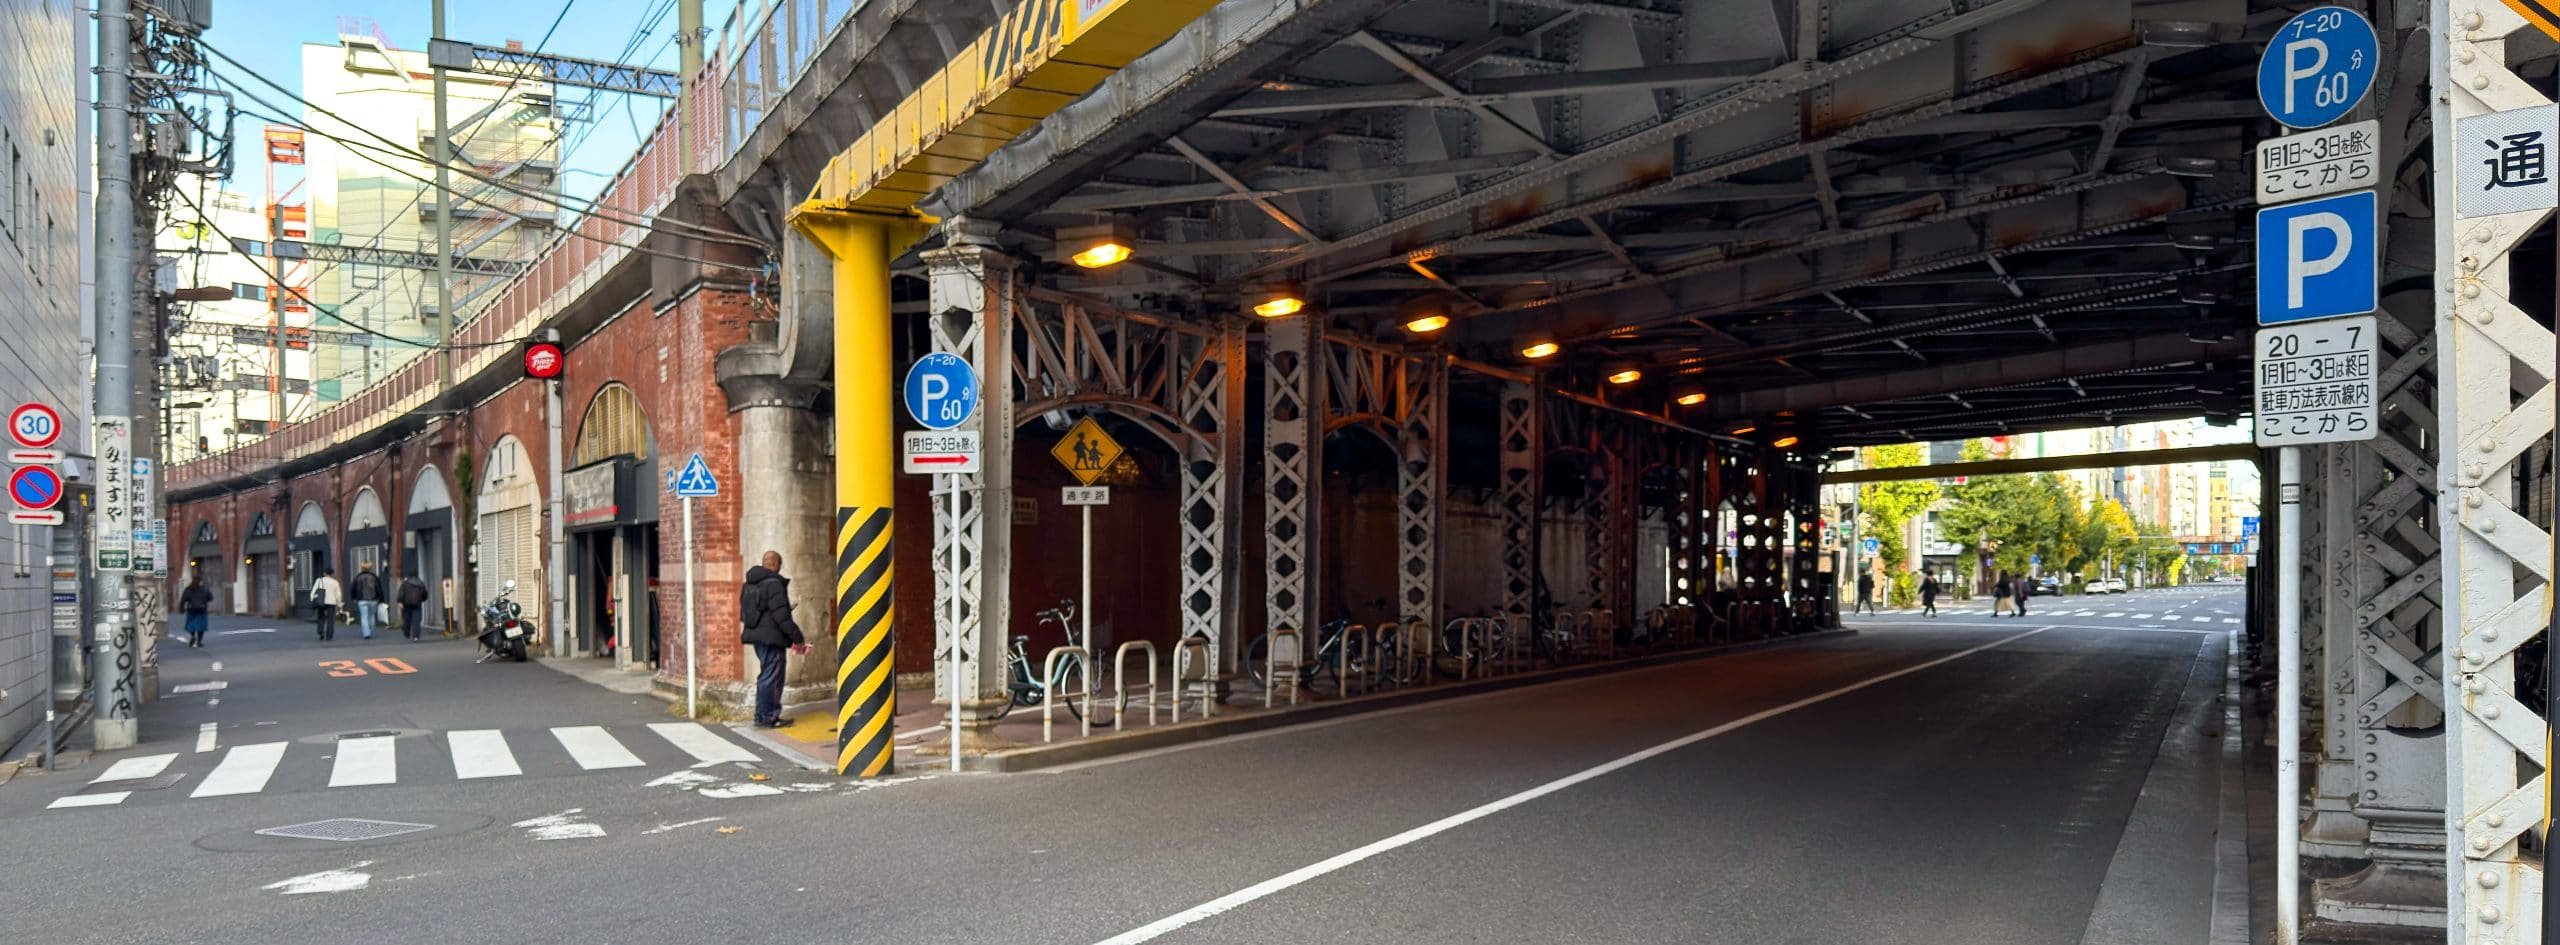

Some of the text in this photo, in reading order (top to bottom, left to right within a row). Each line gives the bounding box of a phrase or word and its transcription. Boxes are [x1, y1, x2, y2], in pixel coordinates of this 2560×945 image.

[2292, 11, 2342, 39] 7-20
[2285, 38, 2329, 114] P
[2484, 131, 2549, 191] 通
[2265, 160, 2371, 194] ここから
[2287, 211, 2353, 310] P
[927, 355, 956, 366] 7-20
[922, 373, 949, 421] P
[2261, 382, 2369, 412] 駐車方法表示線内
[21, 415, 51, 435] 30
[2264, 411, 2368, 437] ここから
[106, 446, 122, 522] みますや
[1066, 490, 1105, 501] 通学路
[318, 657, 419, 677] 30
